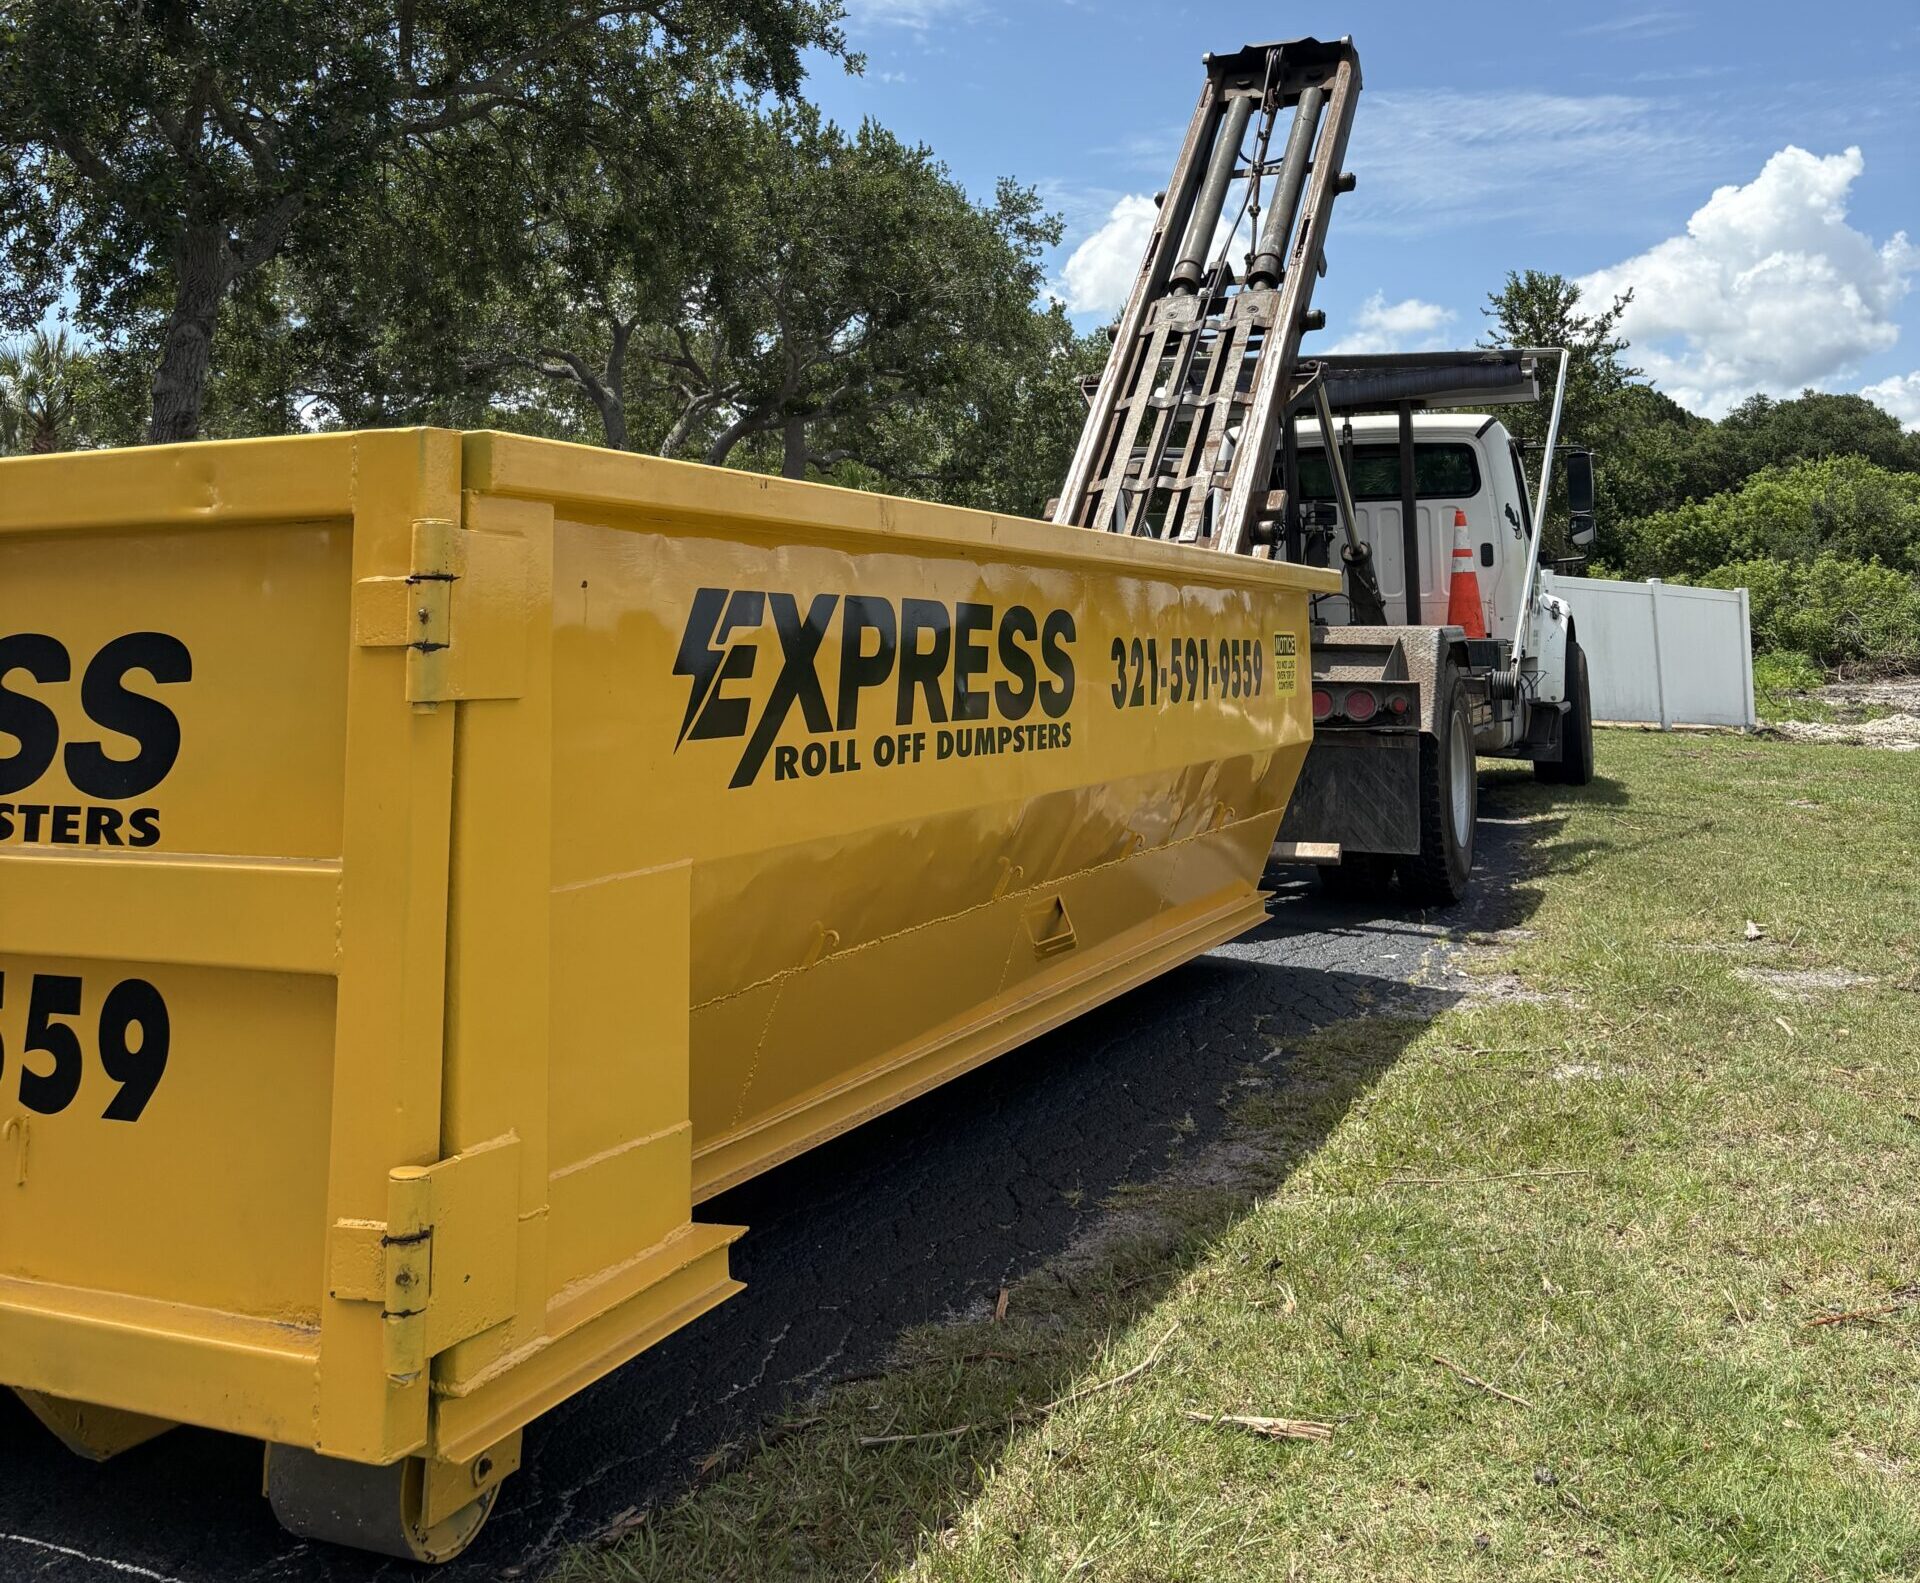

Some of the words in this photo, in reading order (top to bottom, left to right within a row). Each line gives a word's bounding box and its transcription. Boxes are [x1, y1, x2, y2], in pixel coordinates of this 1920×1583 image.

[1111, 637, 1262, 709] 321-591-9559
[1275, 636, 1295, 654] NOTICE
[673, 588, 1076, 789] EXPRESS
[774, 739, 861, 781] ROLL
[873, 732, 925, 767] OFF
[937, 722, 1071, 760] DUMPSTERS
[0, 971, 170, 1122] 59
